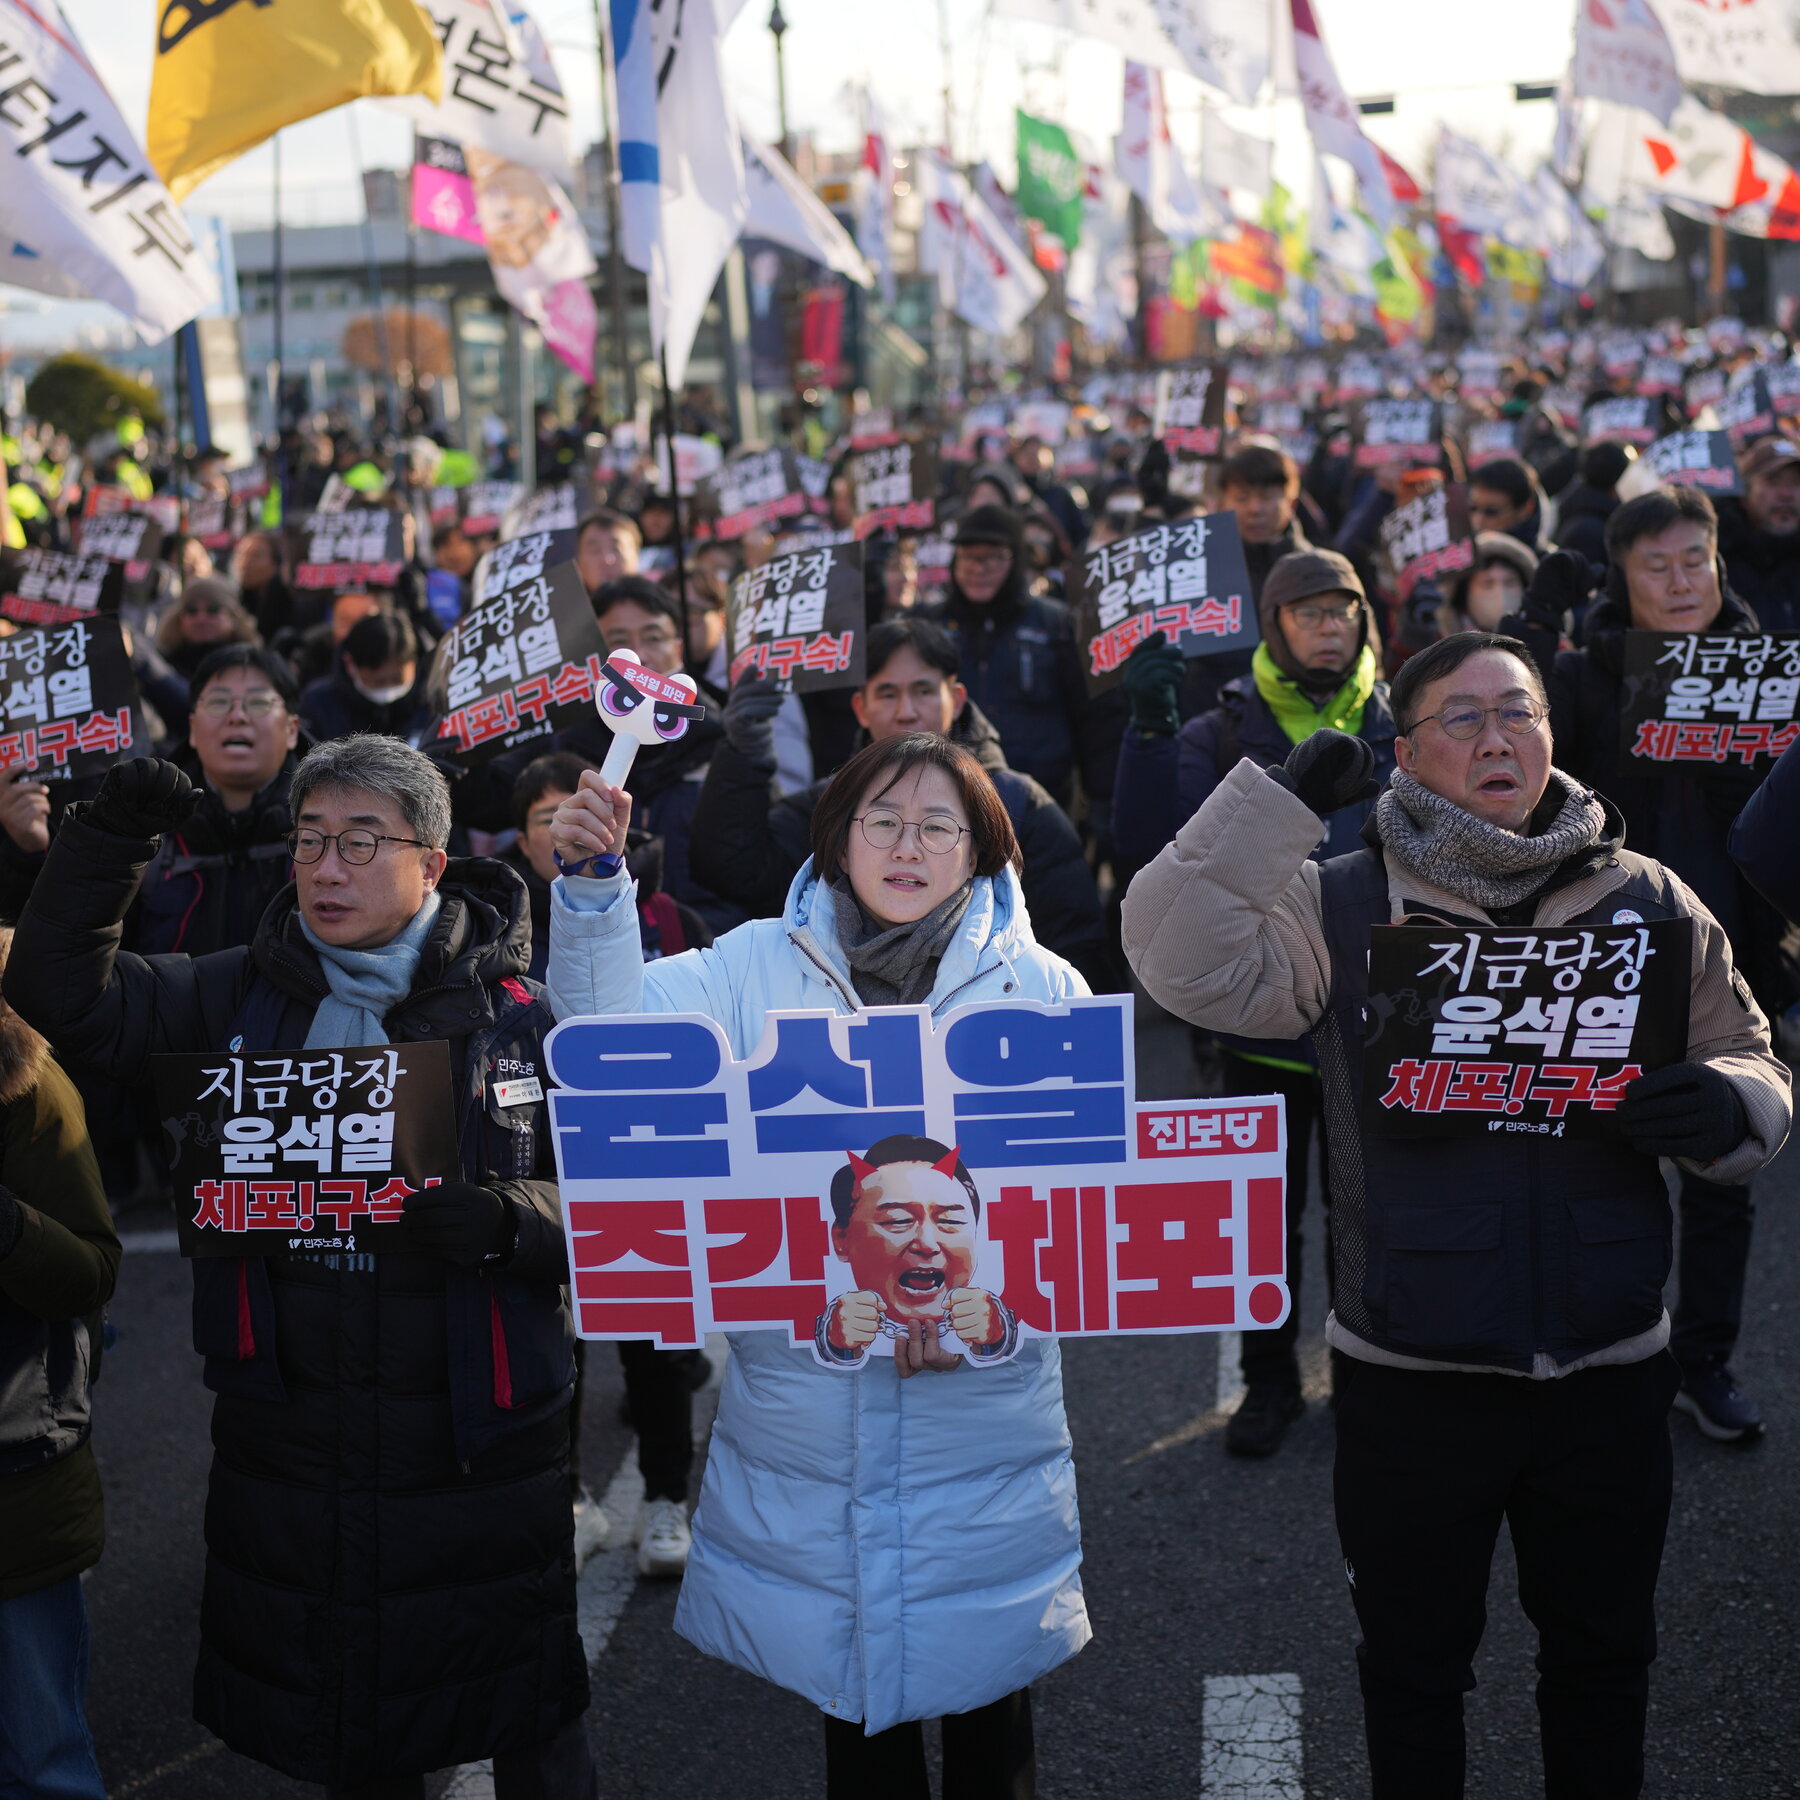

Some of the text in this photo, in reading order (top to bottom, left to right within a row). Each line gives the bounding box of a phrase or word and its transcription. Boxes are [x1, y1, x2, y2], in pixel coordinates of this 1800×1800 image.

[732, 548, 837, 611] 지금당장
[1084, 518, 1212, 589] 지금당장
[440, 576, 554, 670] 지금당장
[734, 588, 828, 653] 윤석열
[1098, 557, 1208, 630] 윤석열
[0, 665, 93, 723] 석열
[447, 618, 563, 710] 윤석열
[622, 667, 687, 705] 윤석열 파면
[1664, 676, 1800, 721] 윤석열
[1417, 928, 1656, 992] 지금당장
[1431, 994, 1641, 1058] 윤석열
[196, 1050, 408, 1113] 지금당장
[498, 1058, 536, 1076] 민주노총
[551, 1005, 1127, 1180] 윤석열
[220, 1111, 396, 1174] 윤석열
[1148, 1112, 1262, 1151] 진보당
[1505, 1121, 1550, 1133] 민주노총
[303, 1237, 343, 1249] 민주노총
[568, 1176, 1284, 1344] 즉각 체포!
